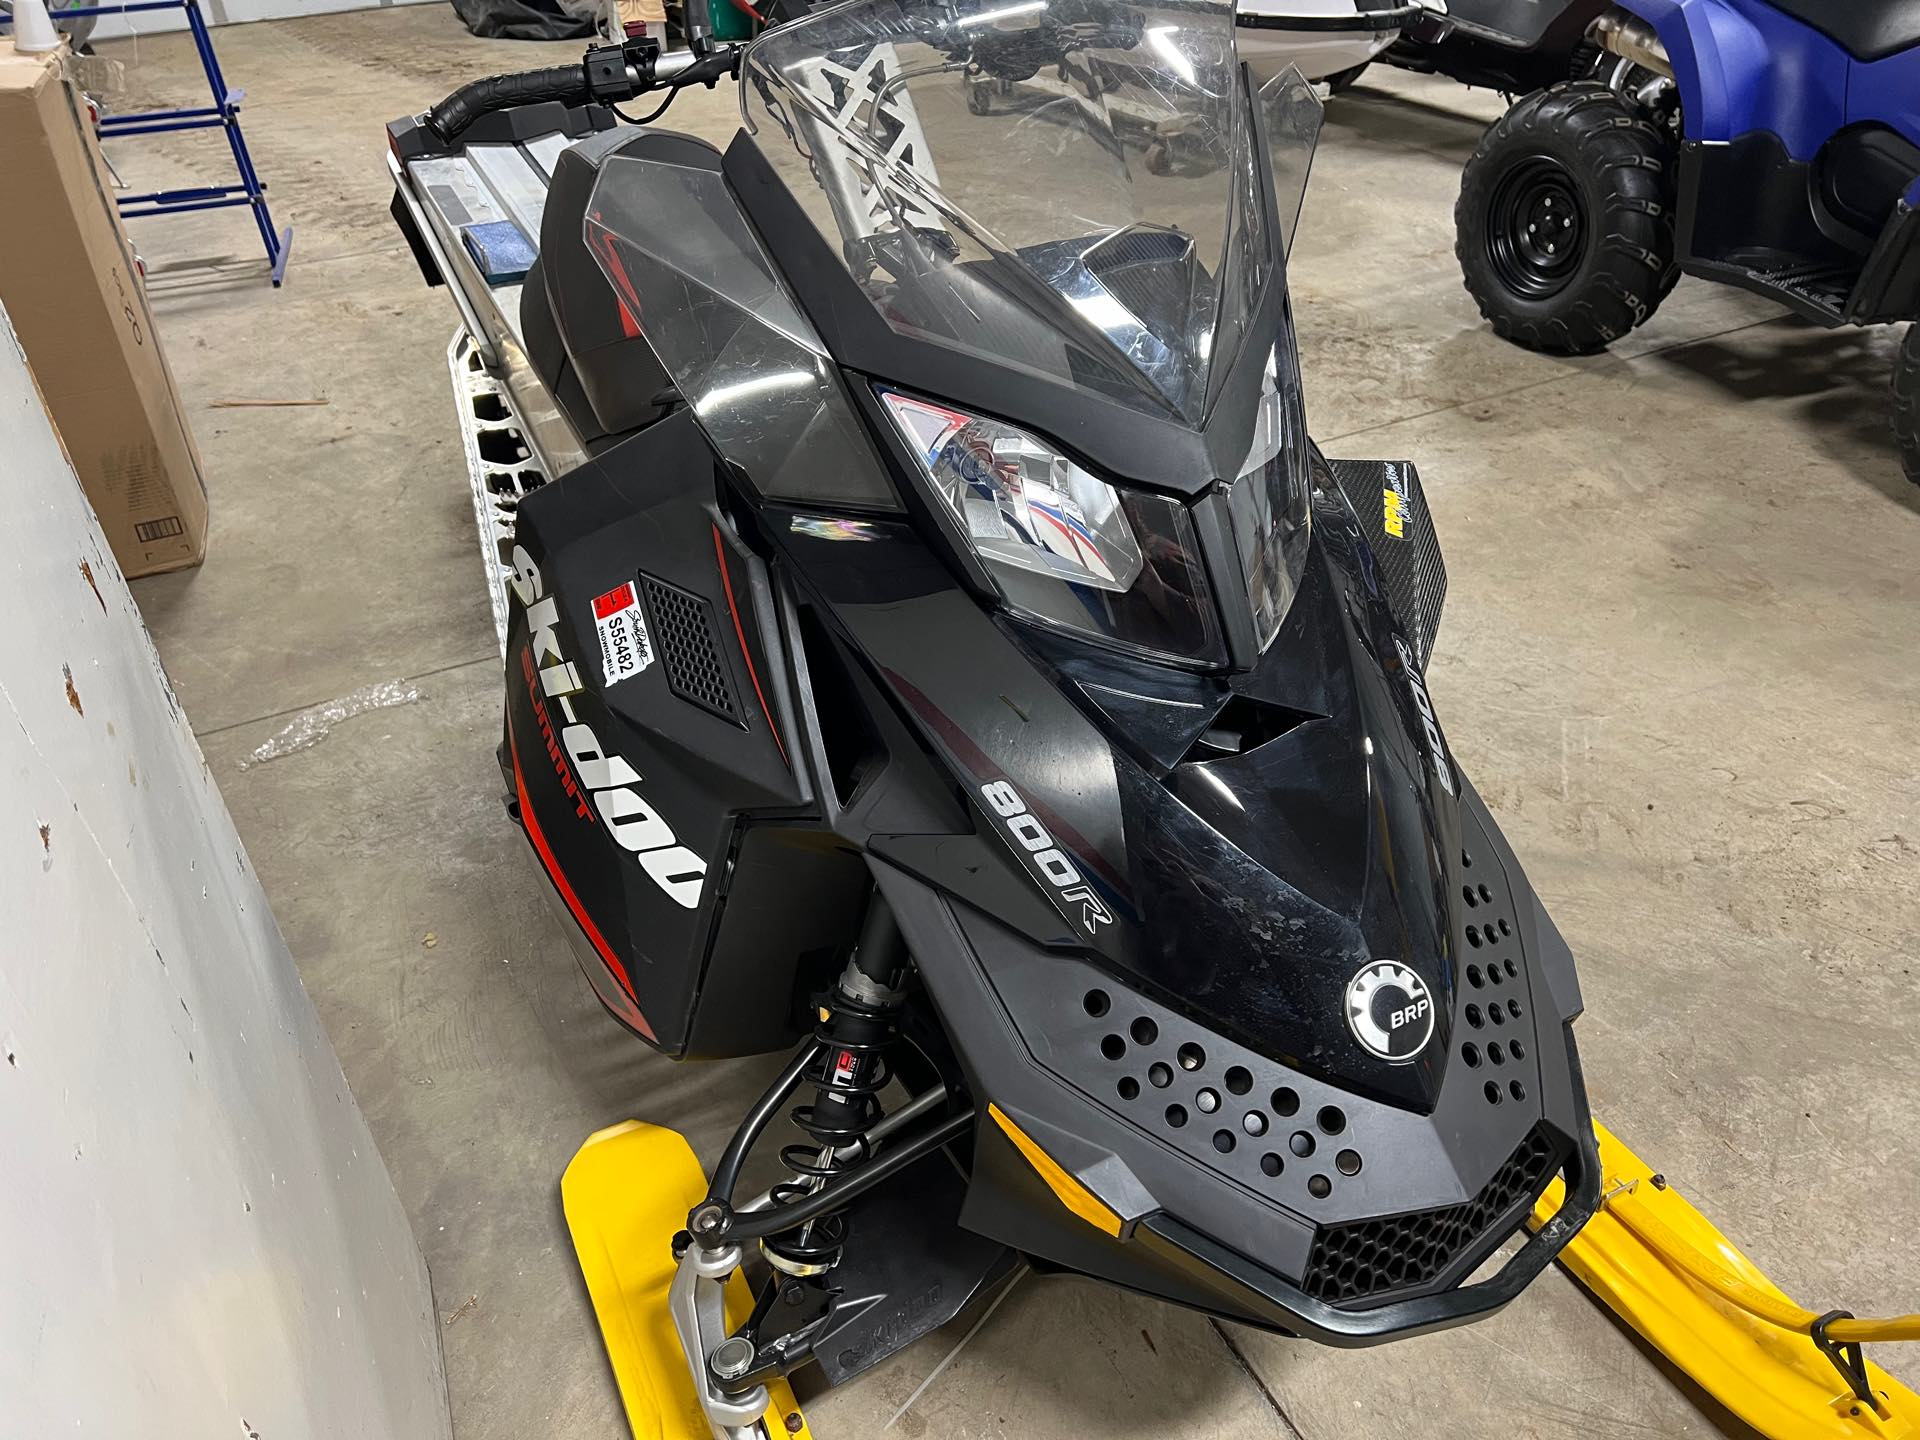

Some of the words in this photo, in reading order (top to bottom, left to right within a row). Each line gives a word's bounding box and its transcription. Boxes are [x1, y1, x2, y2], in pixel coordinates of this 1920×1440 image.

[1384, 489, 1405, 538] RPM
[599, 626, 615, 676] SNOWMOBILE
[608, 616, 634, 674] S55482
[520, 646, 596, 824] SUMMIT
[981, 780, 1113, 934] 800R
[1391, 999, 1428, 1030] BRP
